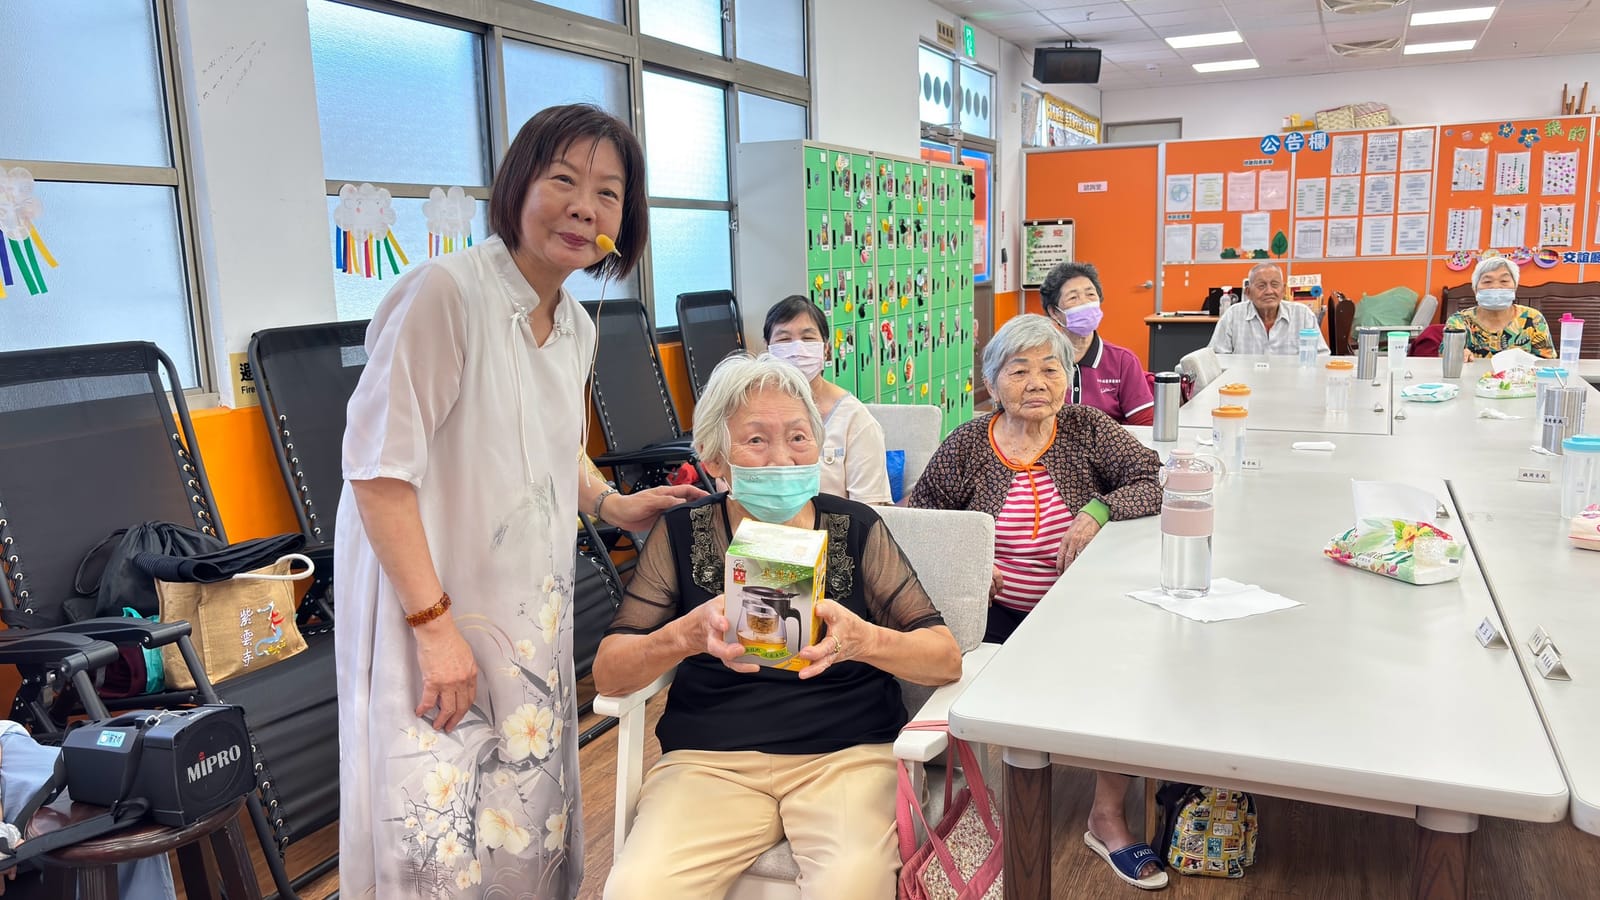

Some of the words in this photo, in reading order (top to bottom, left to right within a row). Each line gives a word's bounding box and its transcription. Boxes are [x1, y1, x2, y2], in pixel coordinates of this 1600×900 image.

[1260, 132, 1328, 153] 公告欄
[241, 385, 256, 394] Fire
[240, 608, 253, 667] 紫雲寺
